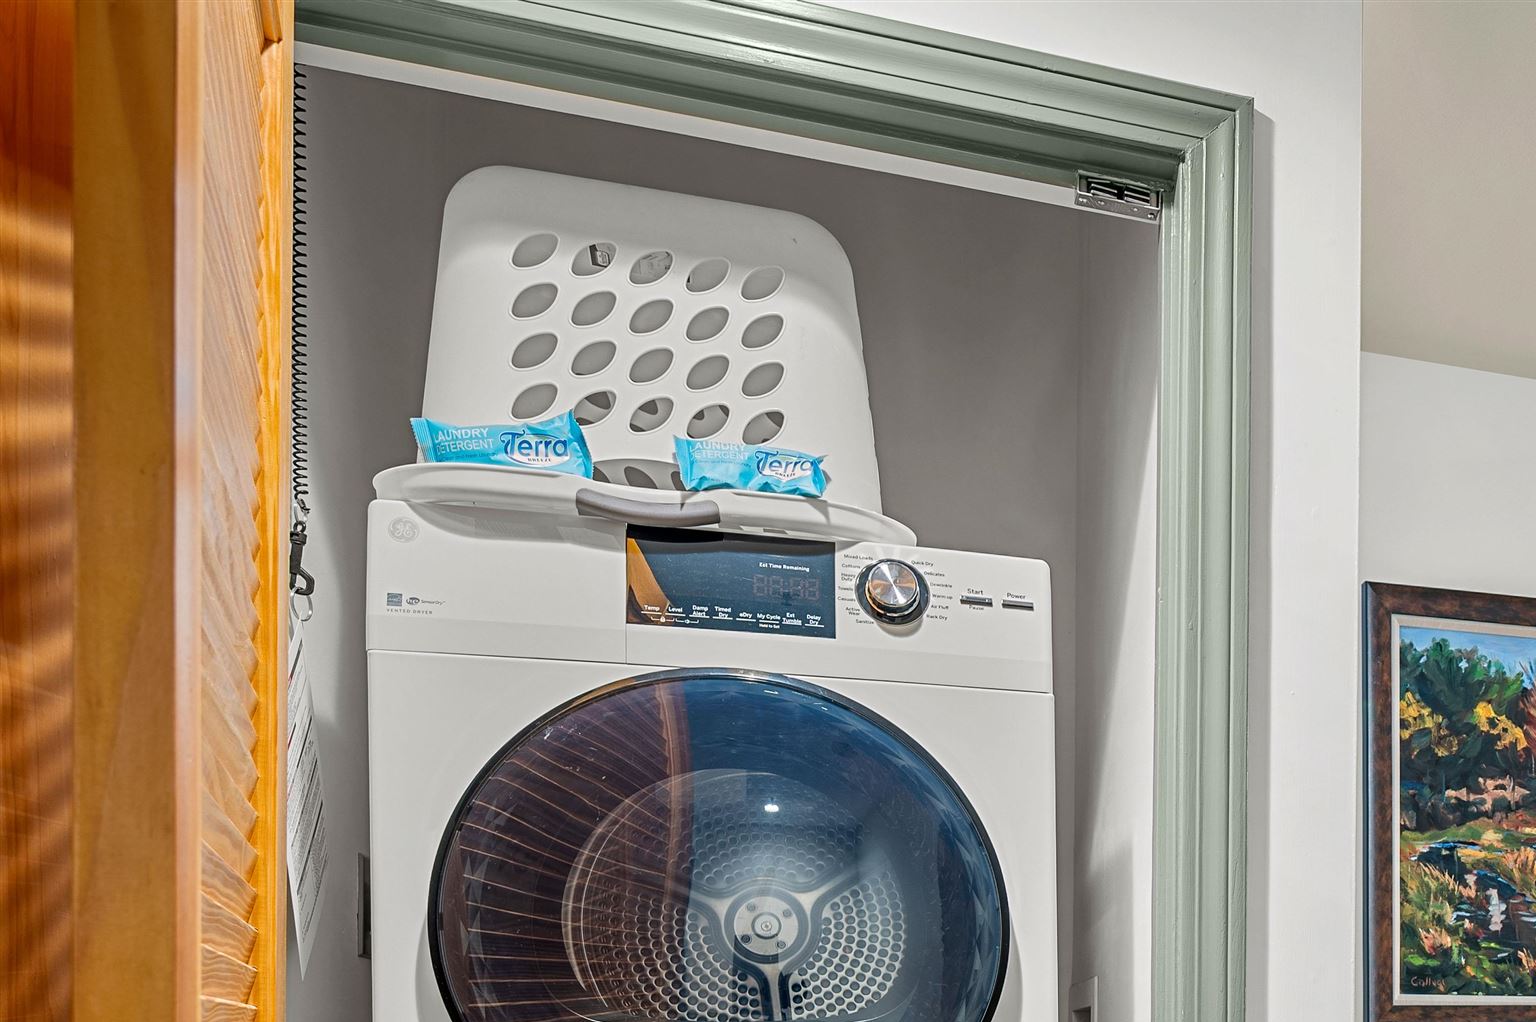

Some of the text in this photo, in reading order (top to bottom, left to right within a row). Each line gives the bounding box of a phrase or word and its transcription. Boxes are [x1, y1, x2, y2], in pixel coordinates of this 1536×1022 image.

[434, 428, 489, 443] LAUNDRY
[437, 439, 494, 455] DETERGENT
[500, 430, 569, 457] Terra
[782, 564, 810, 572] Remaining
